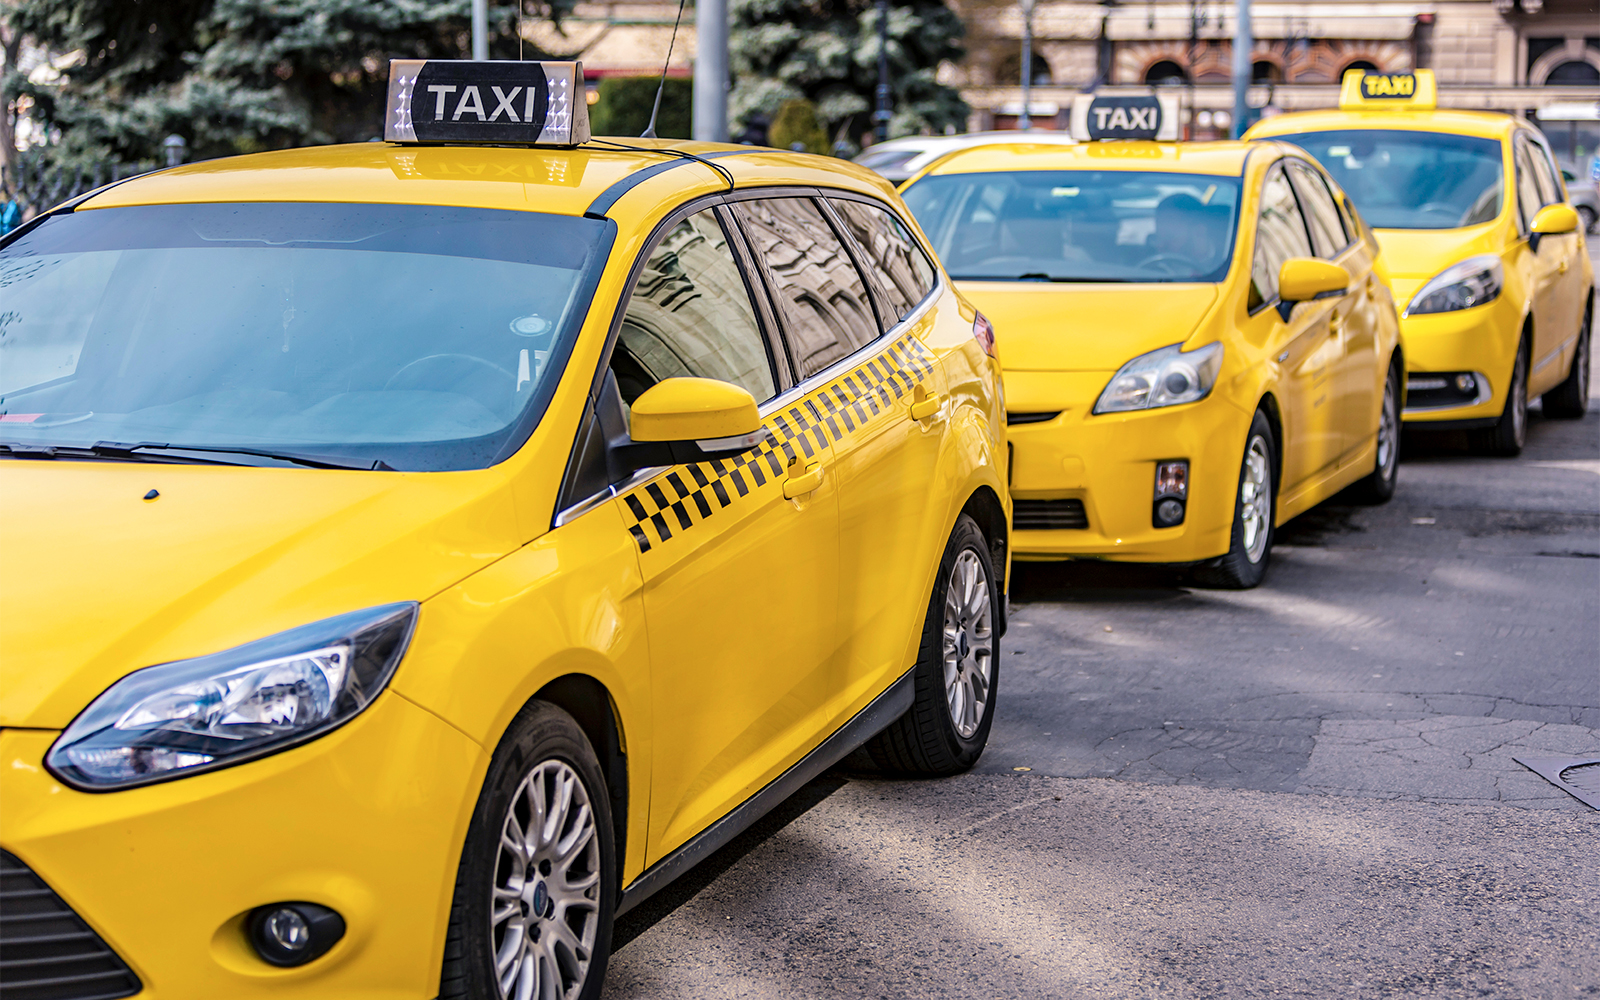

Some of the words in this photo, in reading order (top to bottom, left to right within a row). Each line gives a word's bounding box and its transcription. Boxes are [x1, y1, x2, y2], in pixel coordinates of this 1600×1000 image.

[1364, 75, 1414, 96] TAXI
[427, 85, 536, 123] TAXI
[1093, 107, 1158, 131] TAXI
